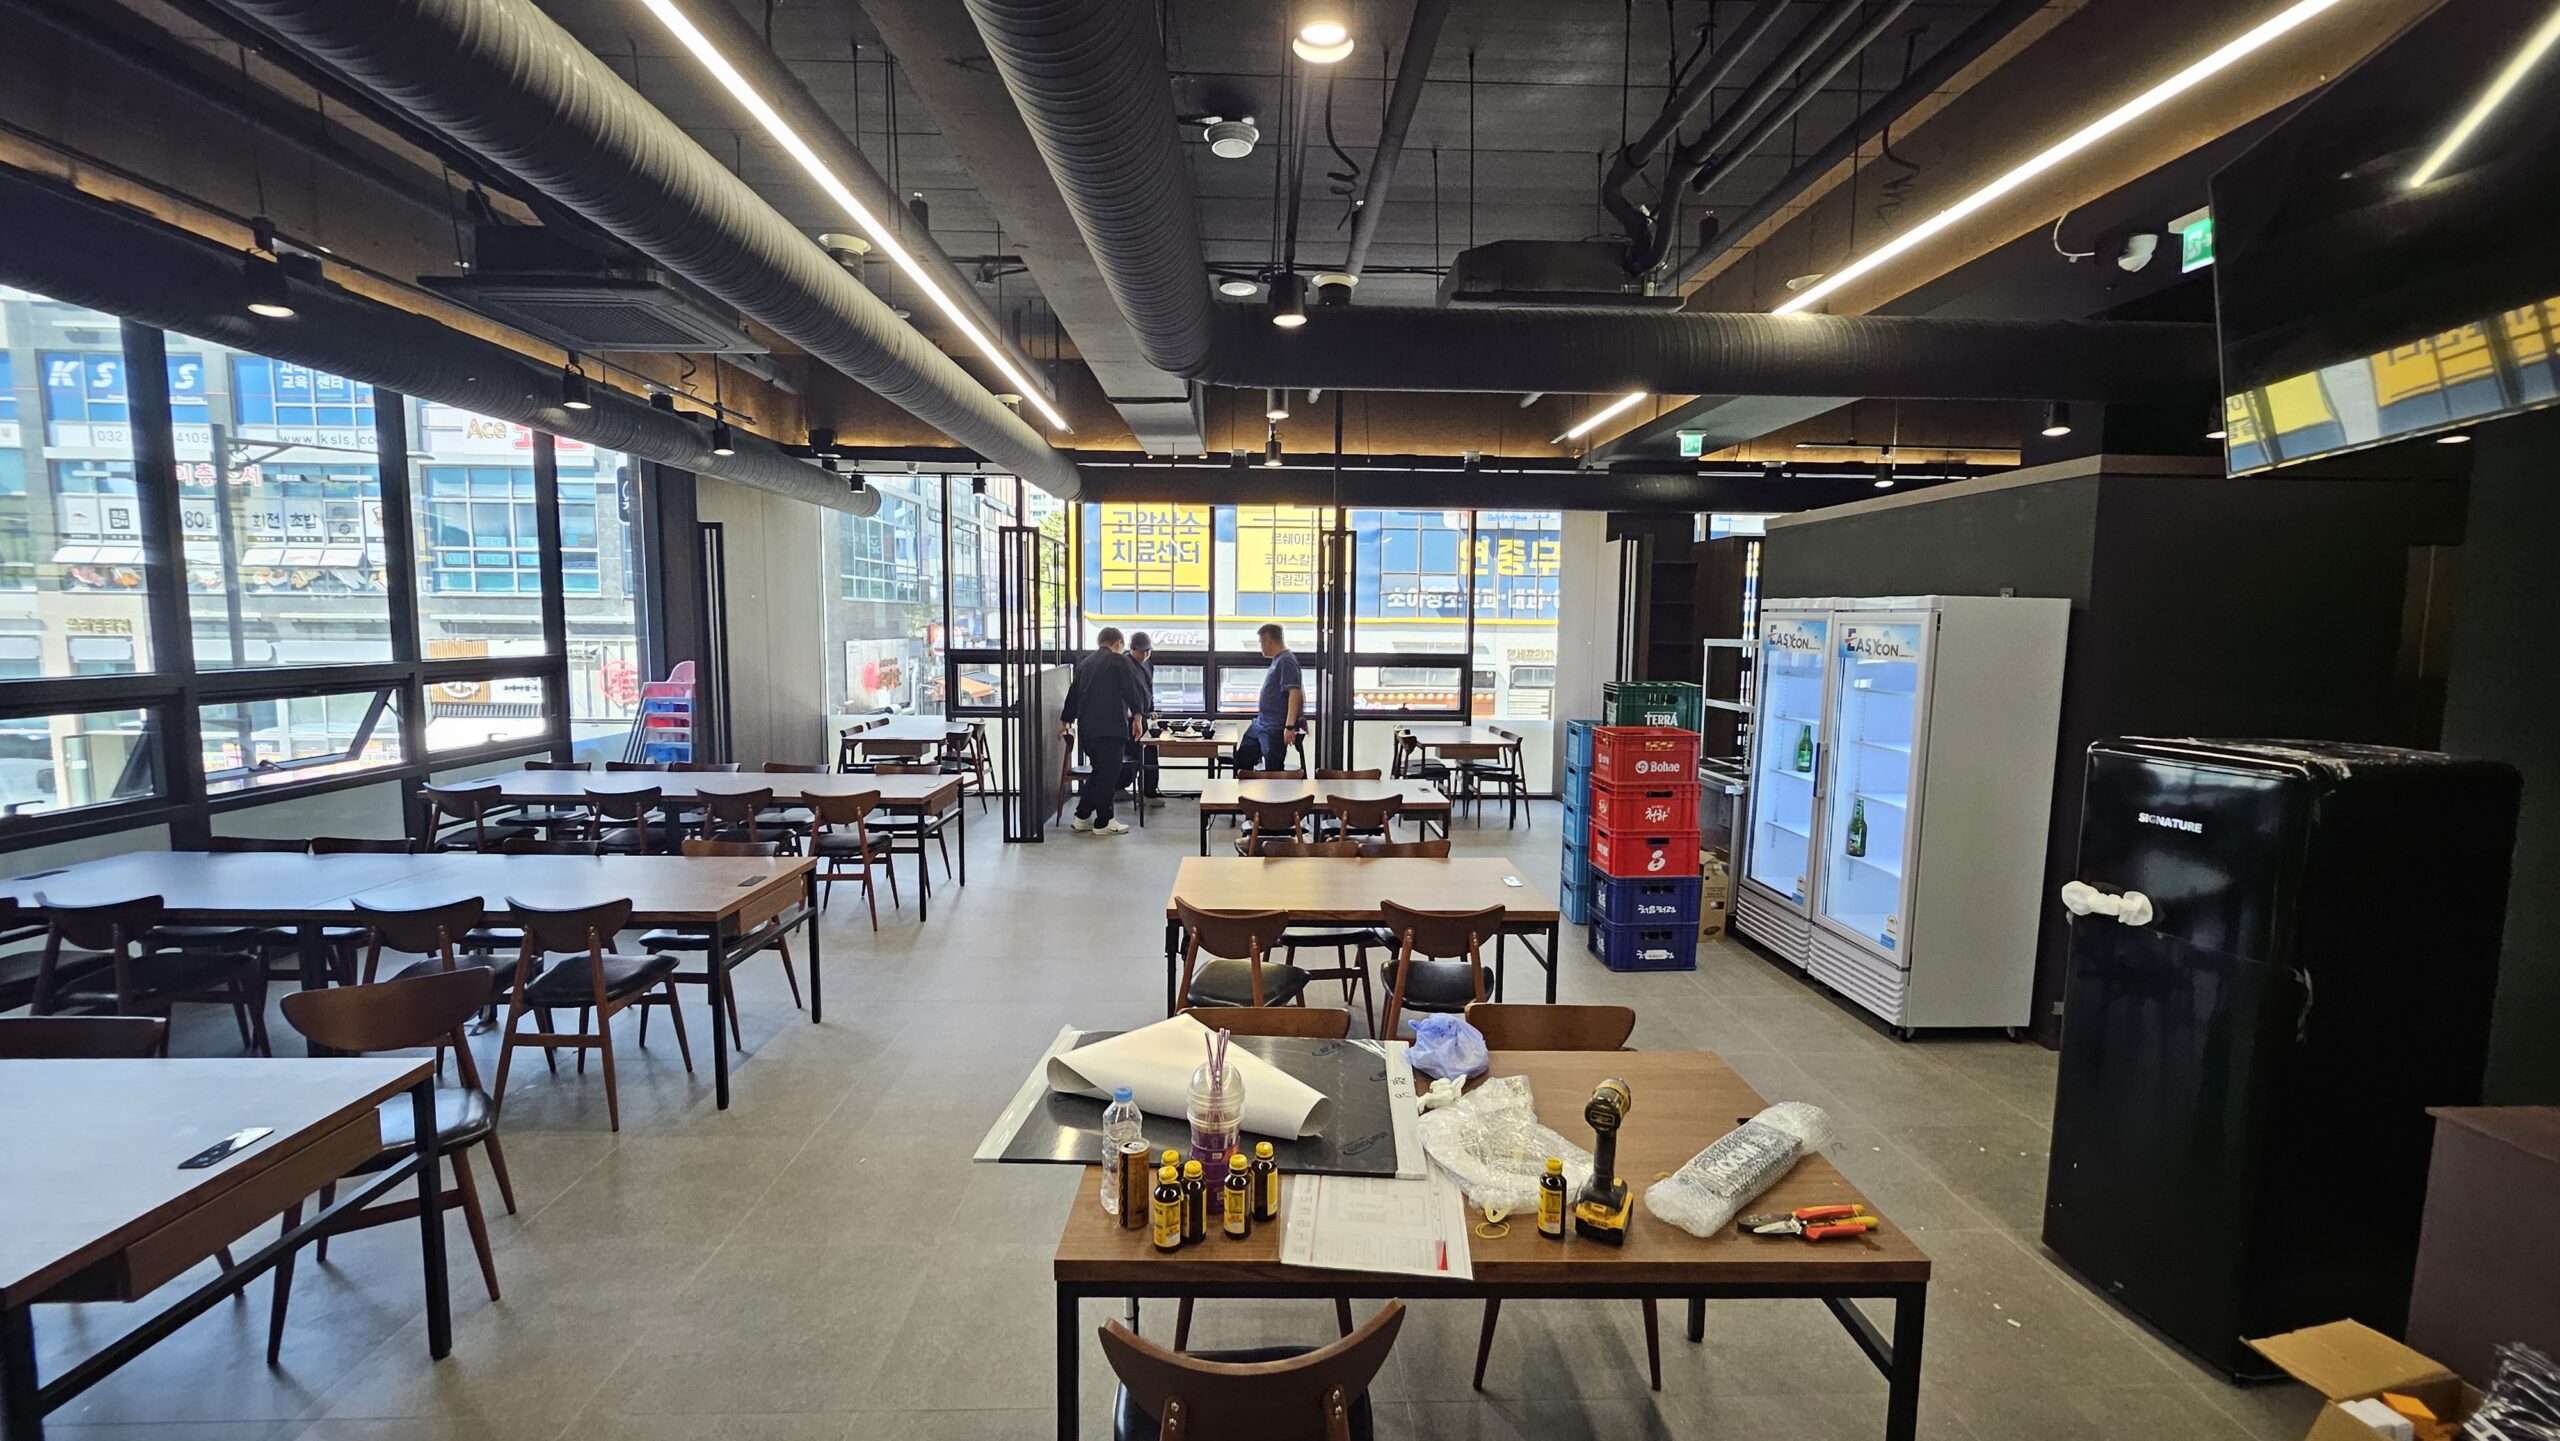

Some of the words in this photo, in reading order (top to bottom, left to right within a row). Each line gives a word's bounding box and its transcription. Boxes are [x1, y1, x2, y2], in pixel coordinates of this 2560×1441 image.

[467, 418, 507, 440] Ace
[1111, 511, 1200, 535] 고압산소
[1111, 539, 1200, 564] 치료센터
[1644, 711, 1678, 726] TERRA
[1650, 761, 1680, 773] Bohae
[2138, 812, 2203, 834] SIGNATURE
